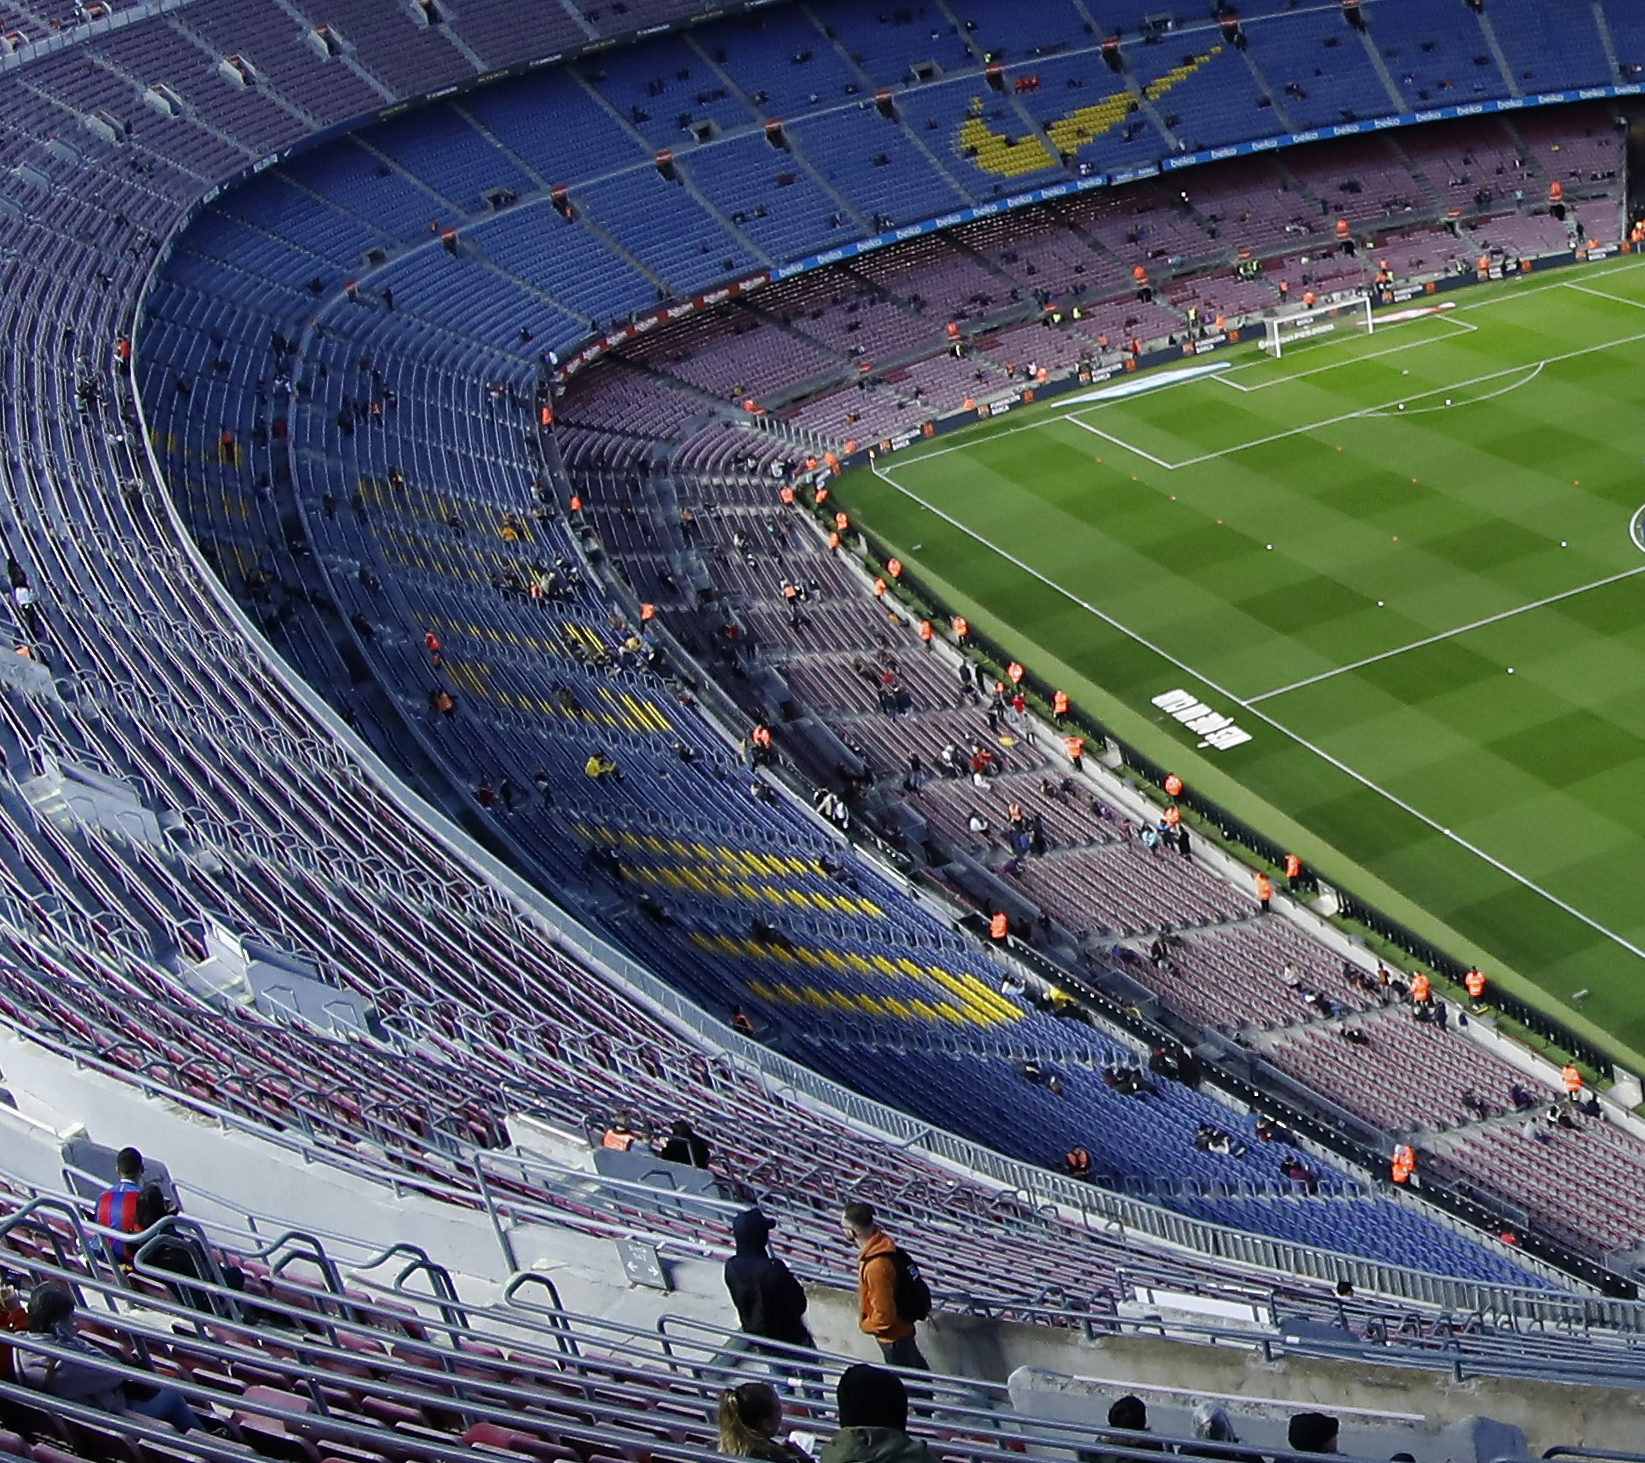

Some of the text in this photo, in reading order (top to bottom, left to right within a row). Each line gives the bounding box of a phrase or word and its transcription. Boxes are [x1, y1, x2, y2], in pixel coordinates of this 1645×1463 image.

[1580, 88, 1605, 98] beko
[1615, 84, 1640, 94] beko
[1497, 98, 1523, 109] beko
[1539, 92, 1563, 104] beko
[1457, 104, 1482, 115] beko
[1416, 111, 1441, 122] beko
[1375, 117, 1399, 128] beko
[1334, 124, 1359, 135] beko
[1293, 132, 1318, 142] beko
[1252, 140, 1277, 150] beko
[1211, 148, 1237, 158] beko
[1171, 156, 1195, 166] beko
[1077, 177, 1103, 190] beko
[1041, 186, 1066, 198] beko
[1007, 194, 1032, 207] beko
[973, 204, 998, 217] beko
[936, 214, 961, 228] beko
[897, 226, 922, 240] beko
[857, 238, 882, 252] beko
[817, 250, 842, 264] beko
[779, 262, 803, 278] beko
